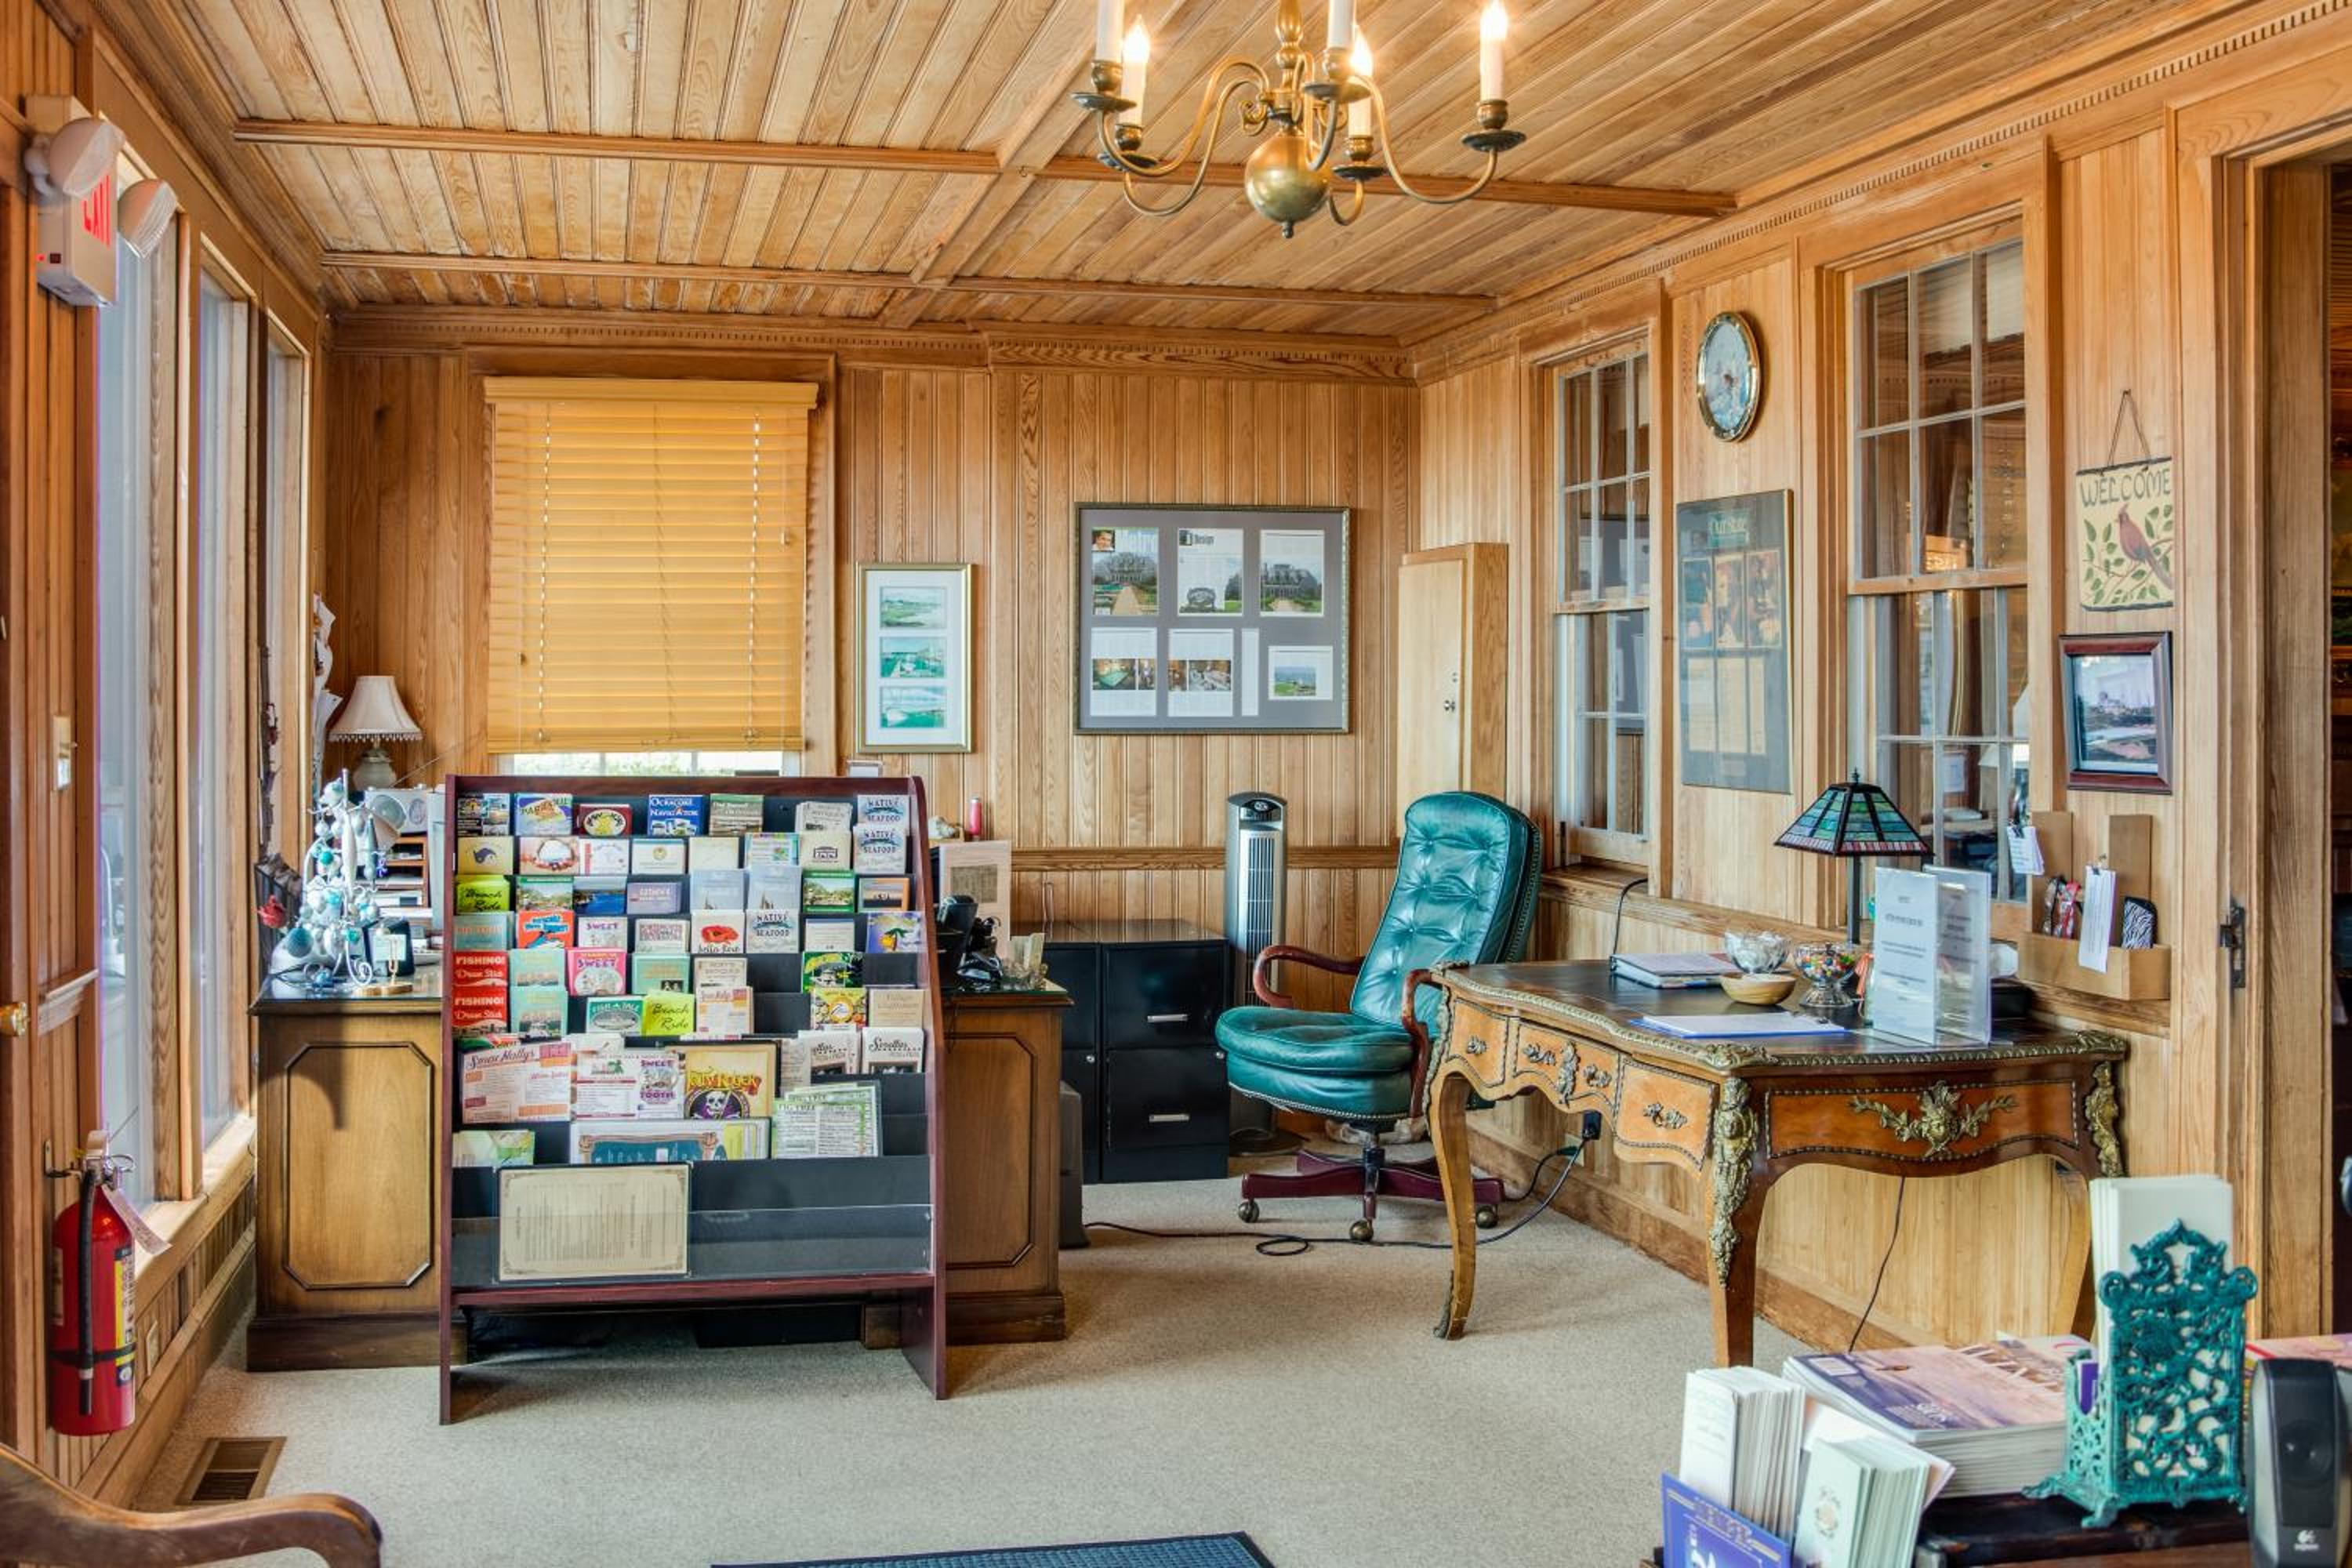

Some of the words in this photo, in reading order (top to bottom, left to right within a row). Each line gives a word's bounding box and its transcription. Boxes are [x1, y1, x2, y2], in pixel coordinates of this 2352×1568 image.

[2080, 468, 2172, 508] WELCOME
[868, 798, 899, 808] NATIVE
[865, 828, 895, 838] NATIVE
[757, 913, 789, 923] NATIVE
[586, 922, 618, 931] SWEET
[456, 956, 505, 965] FISHING!
[578, 958, 616, 968] SWEET
[455, 996, 504, 1006] FISHING!
[640, 1090, 675, 1098] TOOTH
